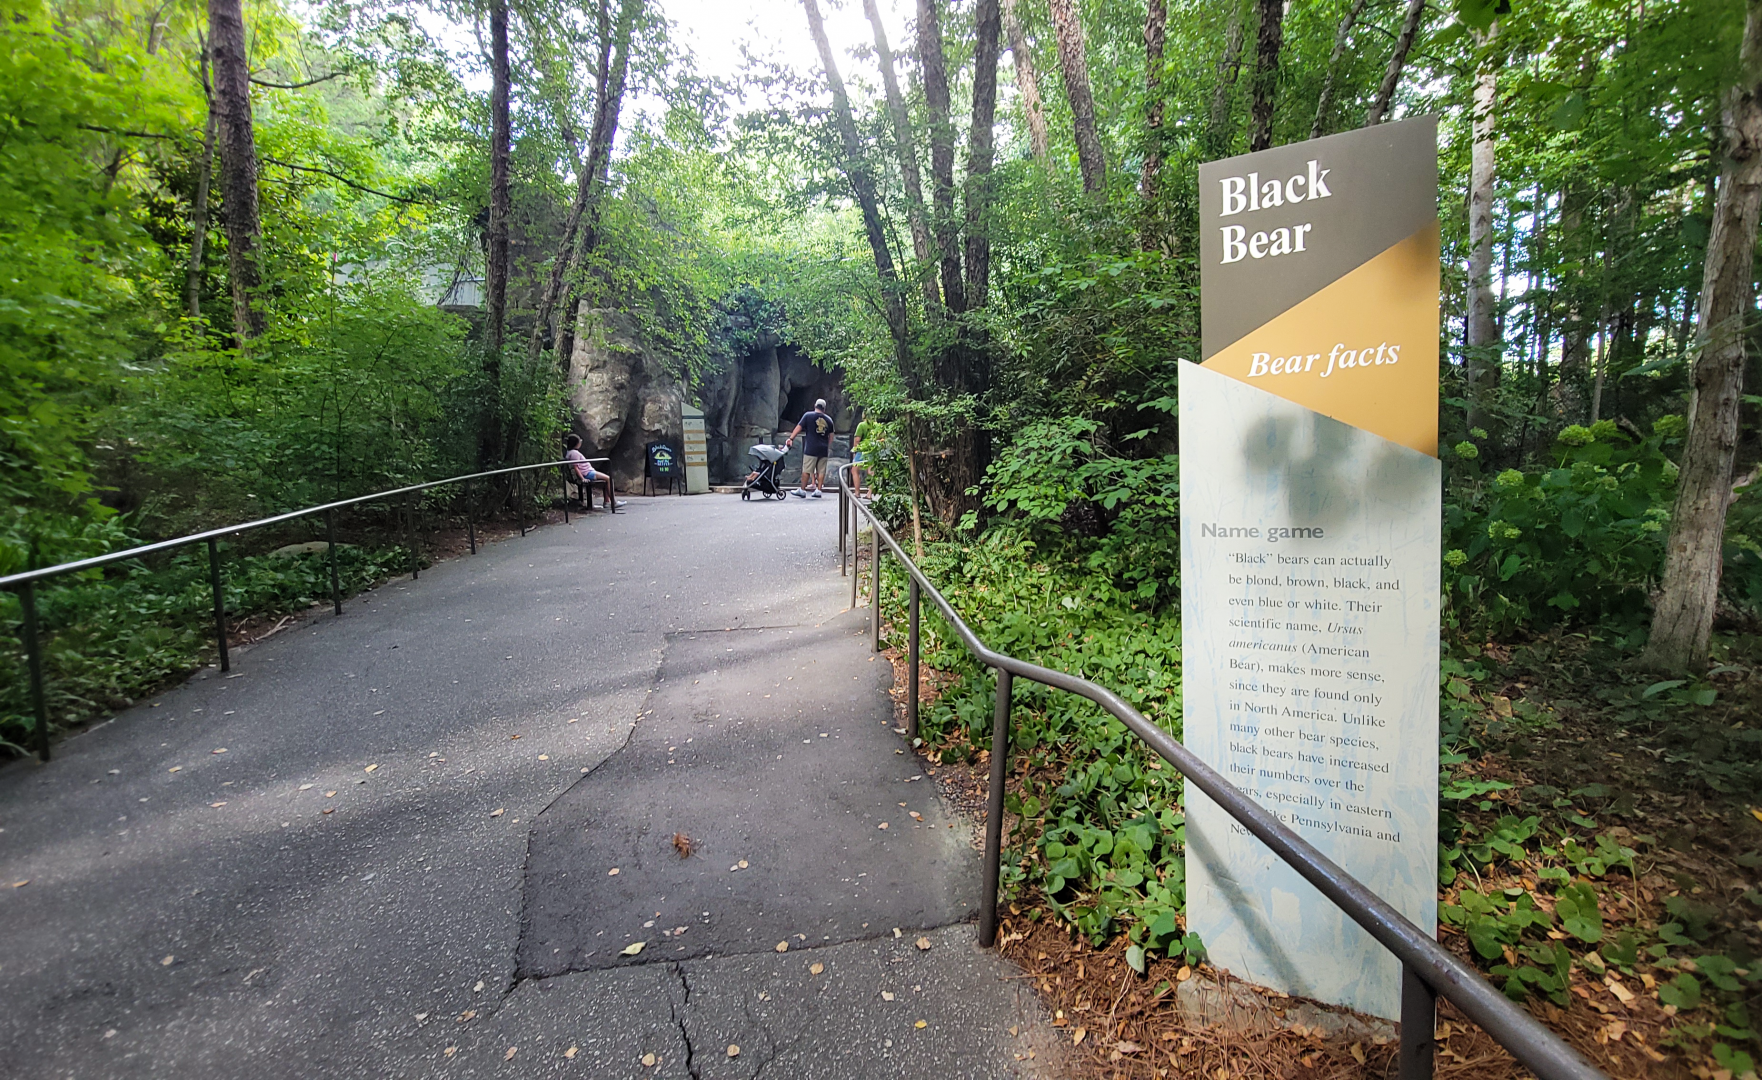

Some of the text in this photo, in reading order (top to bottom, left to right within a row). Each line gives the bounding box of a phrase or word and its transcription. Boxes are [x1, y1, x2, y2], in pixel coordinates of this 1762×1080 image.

[1219, 159, 1332, 217] Black
[1219, 222, 1312, 264] Bear
[1247, 342, 1401, 378] Bear facts
[1201, 523, 1324, 542] Name game
[1277, 554, 1310, 565] bears
[1313, 556, 1335, 566] can
[1340, 555, 1392, 569] actually
[1228, 574, 1400, 591] be blond, brown, black, and
[1228, 597, 1383, 613] even blue or white. Their
[1228, 617, 1363, 635] scientific name, Ursus
[1228, 639, 1370, 658] americanus (American
[1229, 659, 1385, 683] Bear), makes more sense,
[1229, 680, 1382, 707] since they are found only
[1229, 700, 1386, 728] in North America. Unlike
[1229, 723, 1379, 751] many other bear species,
[1229, 742, 1389, 774] black bears have increased
[1229, 763, 1365, 792] their numbers over the
[1236, 786, 1392, 819] ars, especially in eastern
[1266, 809, 1401, 843] ke Pennsylvania and
